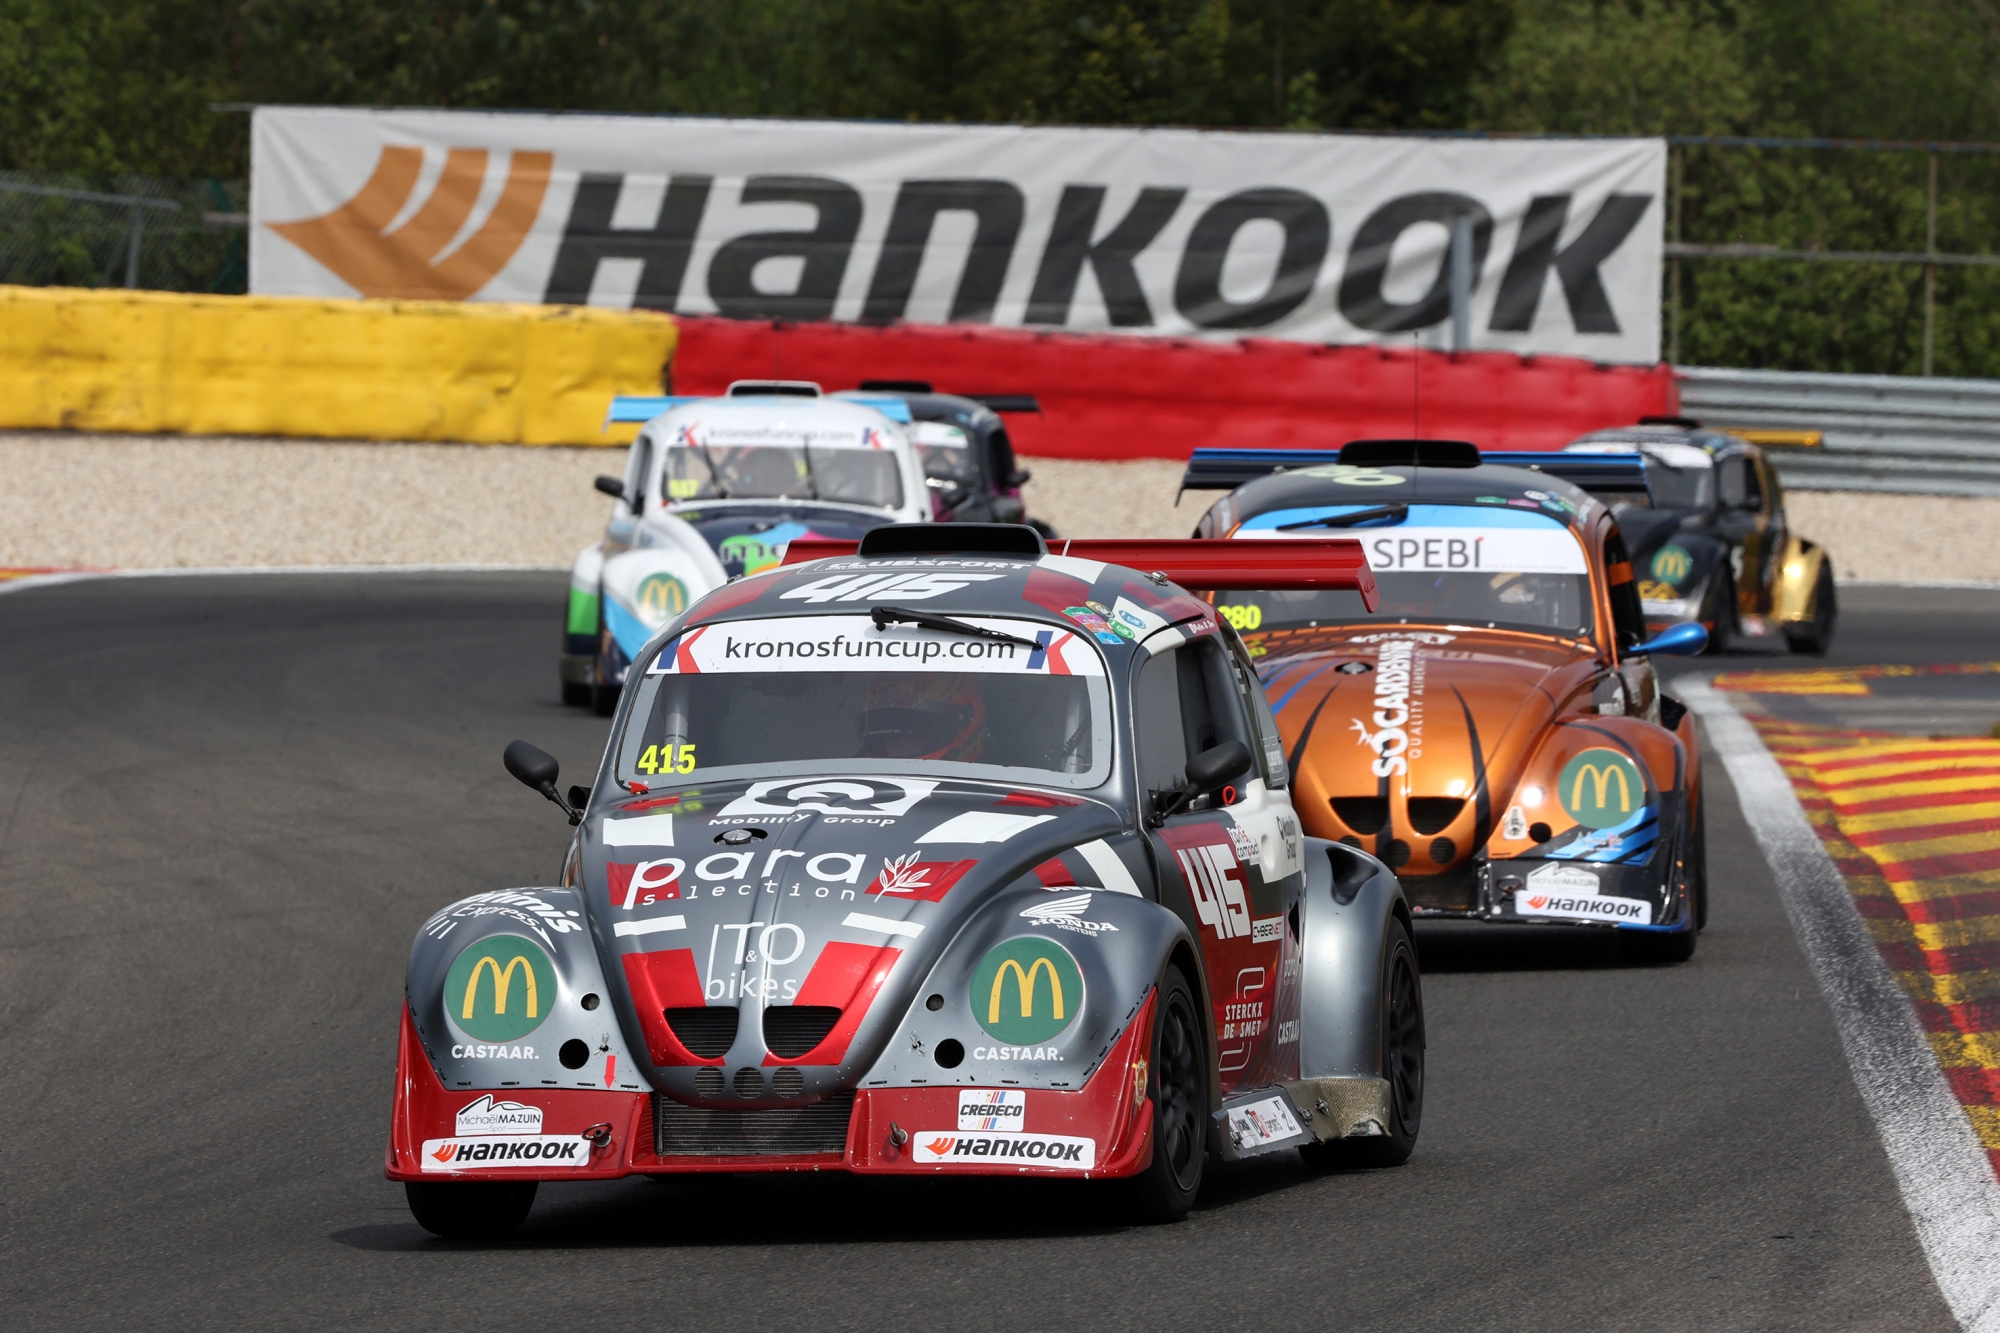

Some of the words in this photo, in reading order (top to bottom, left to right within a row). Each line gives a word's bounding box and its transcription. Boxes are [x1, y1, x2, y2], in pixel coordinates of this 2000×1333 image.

[779, 573, 1007, 603] 415
[725, 635, 1016, 663] kronosfuncup.com
[637, 743, 696, 775] 415
[823, 814, 896, 828] Group
[622, 849, 867, 910] para
[1176, 844, 1251, 939] 415
[452, 903, 540, 928] Express
[1028, 917, 1119, 931] HONDA
[1056, 924, 1098, 937] MERTENS
[1253, 922, 1282, 938] CYBERNET
[1225, 1001, 1263, 1021] STERCKX
[1223, 1023, 1235, 1040] DE
[1240, 1020, 1262, 1038] SMET
[451, 1044, 540, 1060] CASTAAR.
[973, 1046, 1065, 1062] CASTAAR.
[959, 1104, 1023, 1117] CREDECO
